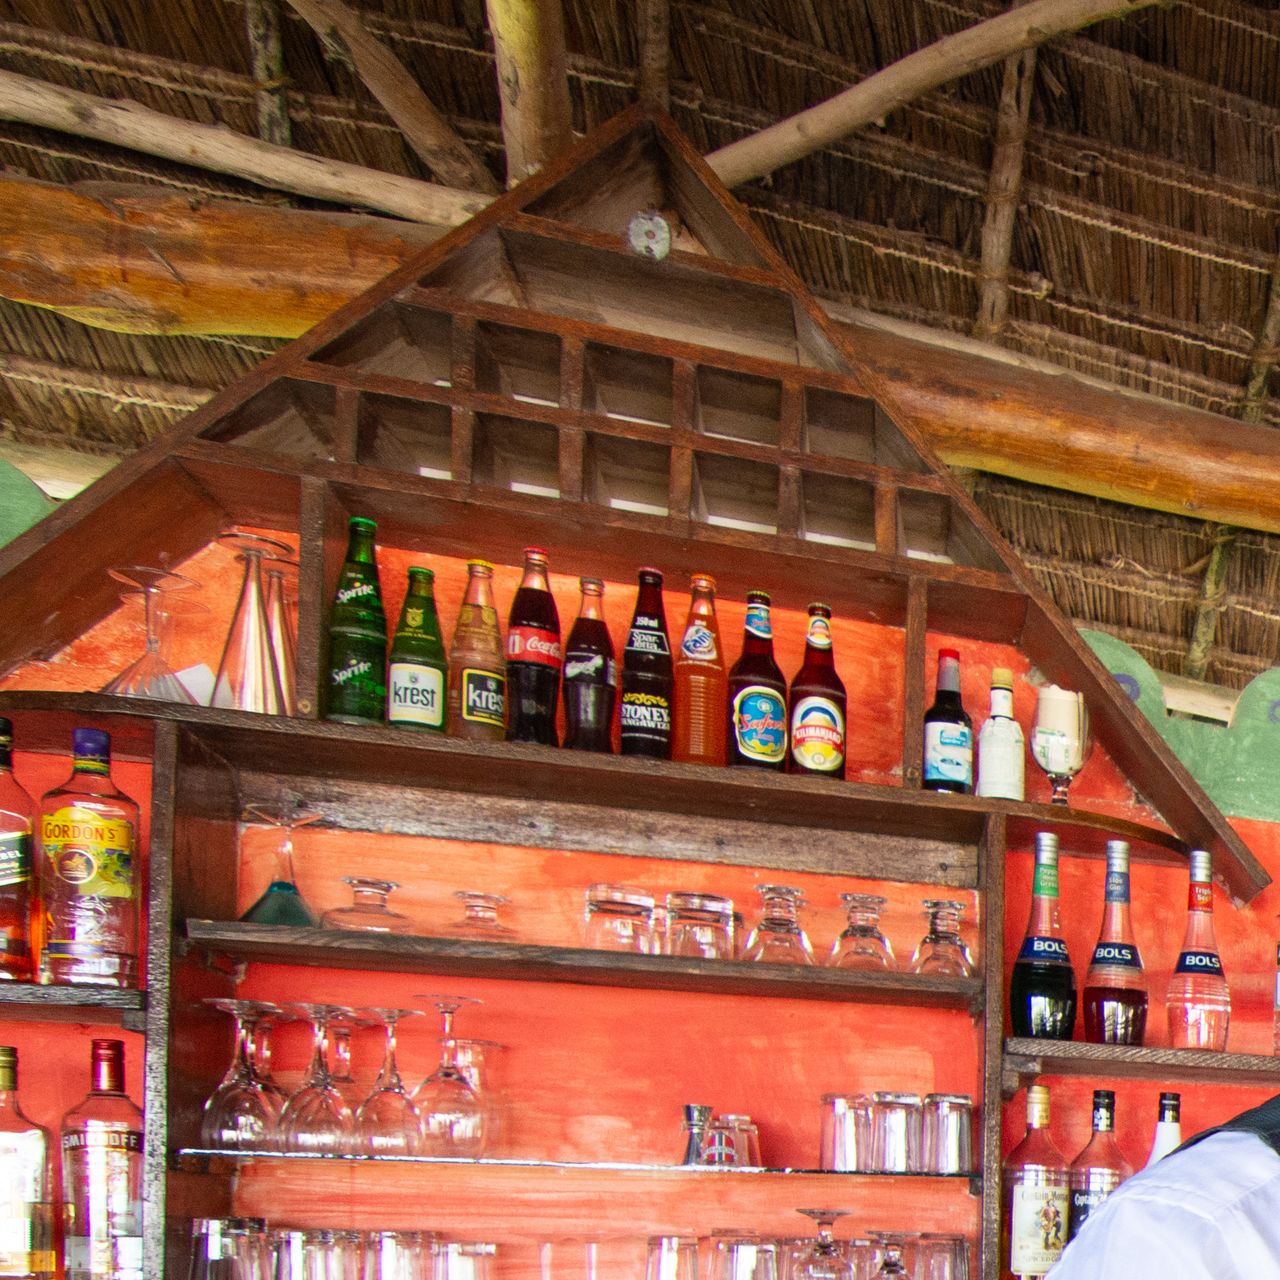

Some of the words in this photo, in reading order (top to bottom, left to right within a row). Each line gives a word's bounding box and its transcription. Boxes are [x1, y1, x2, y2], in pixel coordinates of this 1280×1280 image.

[335, 580, 374, 604] Sprite
[332, 658, 372, 686] Sprite
[393, 681, 437, 708] krest
[467, 683, 503, 712] kres
[44, 821, 116, 843] GORDON'S
[1033, 939, 1068, 954] BOLS
[1095, 947, 1132, 960] BOLS
[1185, 955, 1220, 968] BOLS
[62, 1132, 138, 1149] SMIOFF
